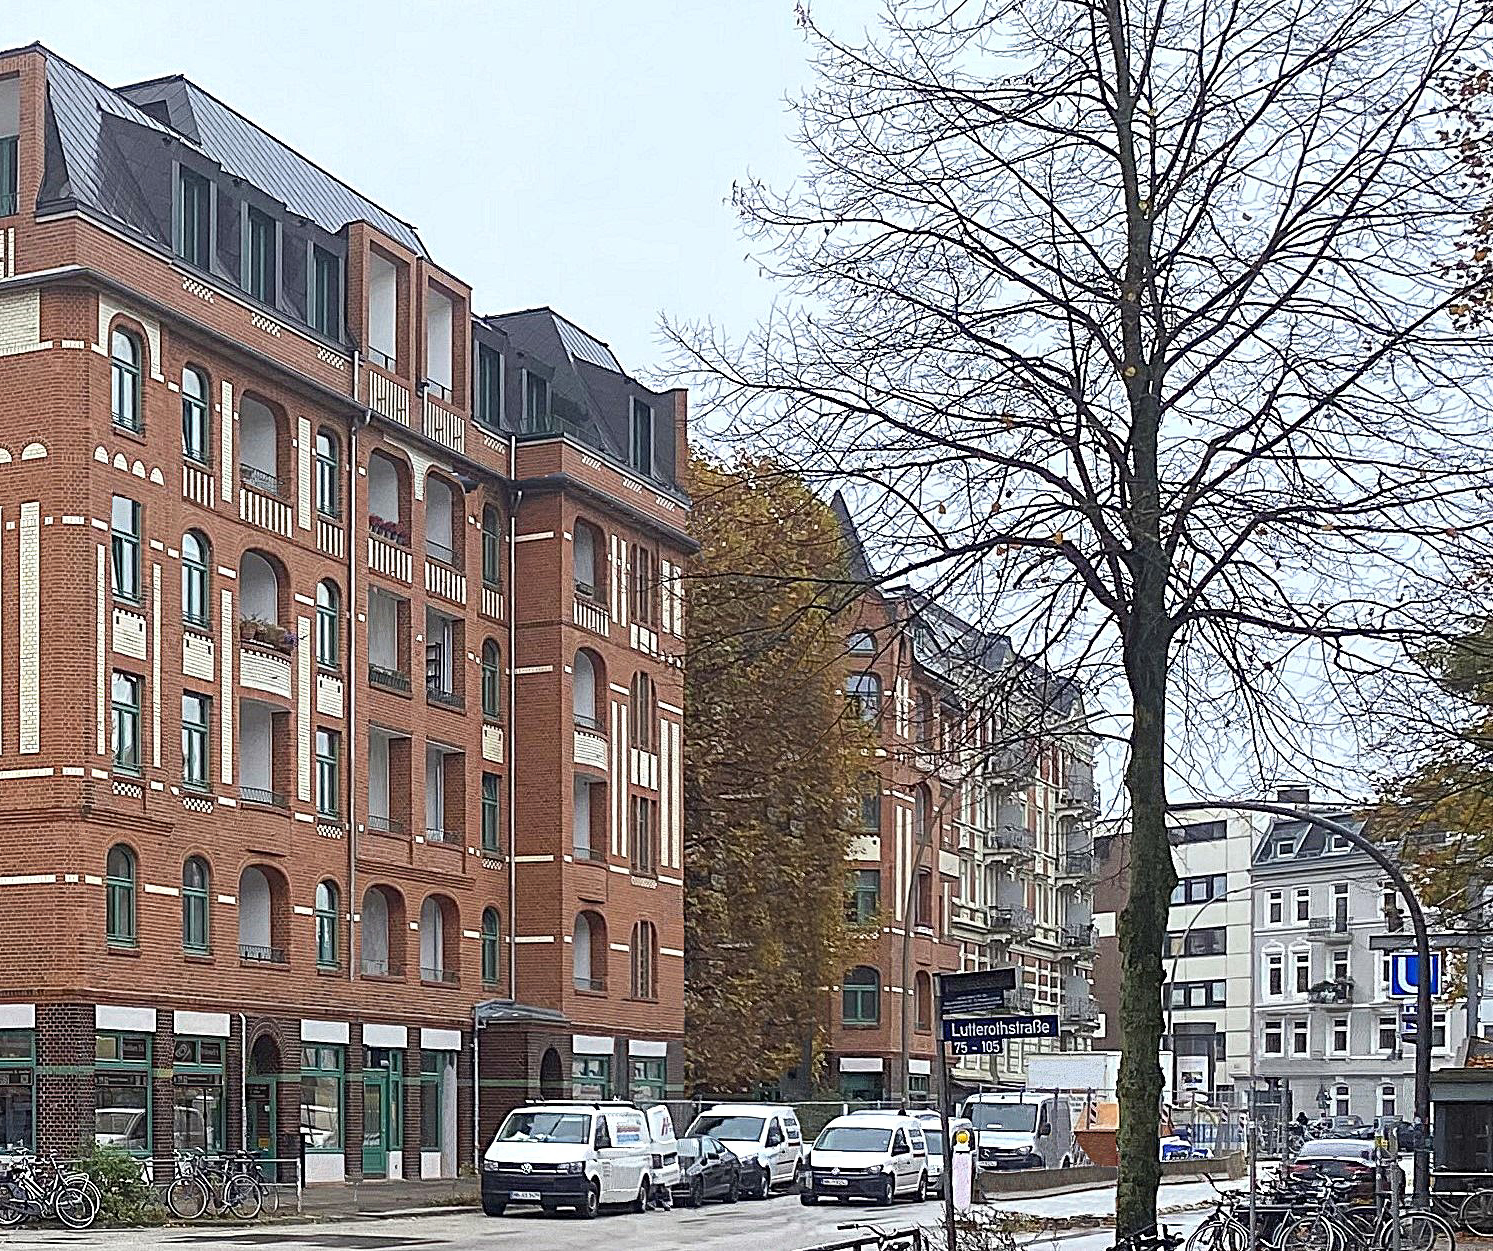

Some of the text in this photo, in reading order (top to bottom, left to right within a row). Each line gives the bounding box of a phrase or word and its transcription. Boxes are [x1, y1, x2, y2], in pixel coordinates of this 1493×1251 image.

[951, 1019, 1050, 1037] Lutterothstraße
[953, 1041, 968, 1054] 75
[981, 1040, 1000, 1053] 105
